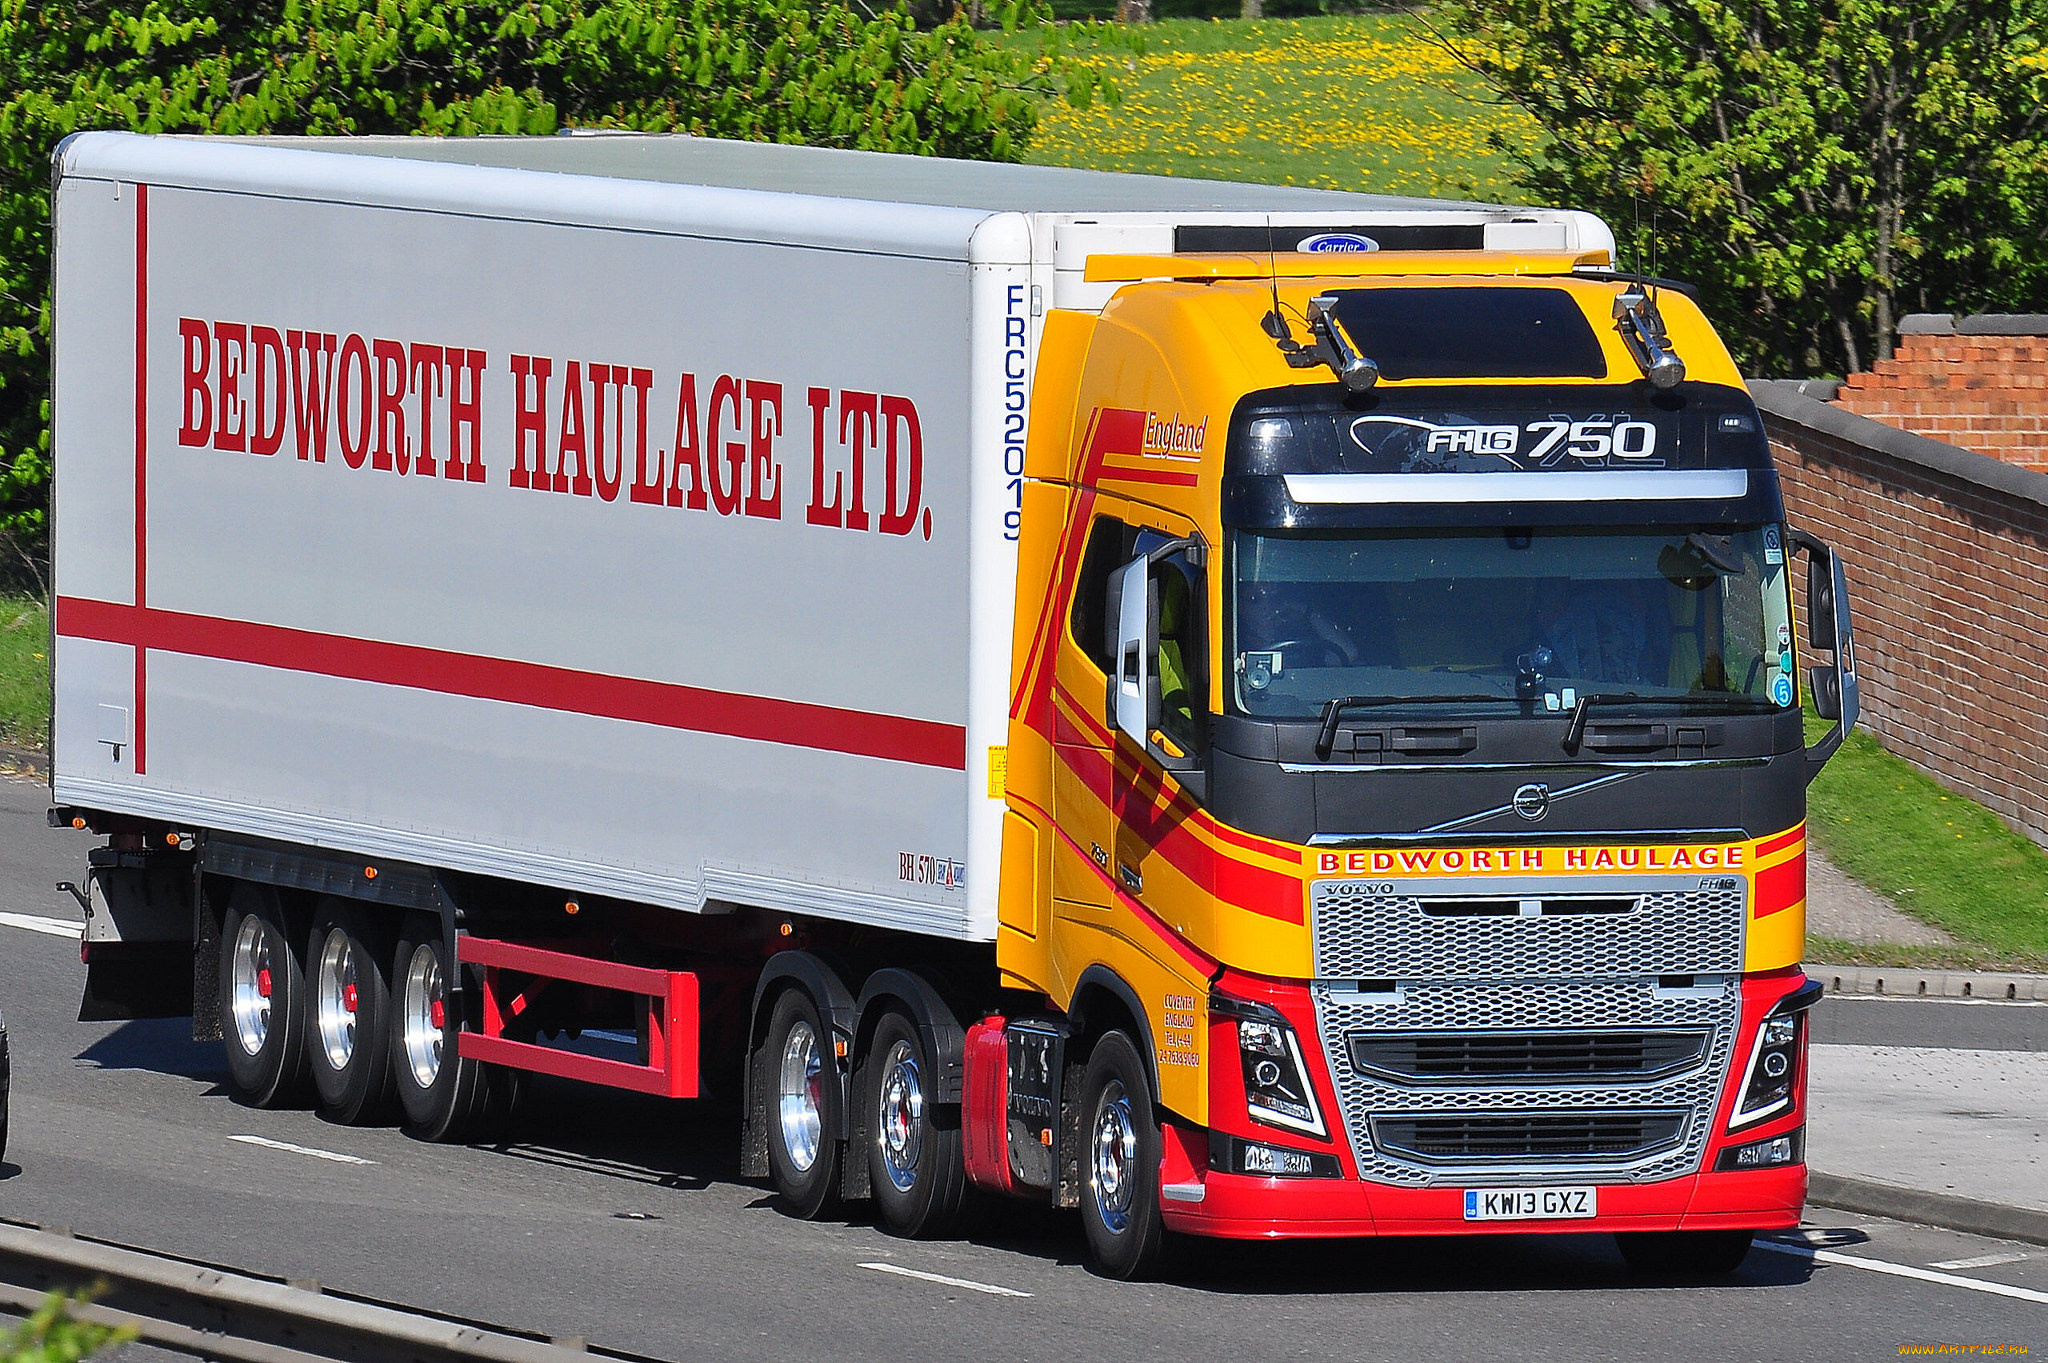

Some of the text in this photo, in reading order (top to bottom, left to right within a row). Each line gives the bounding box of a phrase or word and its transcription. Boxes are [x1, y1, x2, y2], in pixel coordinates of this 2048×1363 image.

[1317, 241, 1360, 253] Carrier
[178, 316, 934, 543] BEDWORTH HAULAGE LTD.
[1145, 411, 1208, 457] England
[1427, 421, 1657, 458] FH16 750
[899, 851, 915, 882] BH
[918, 855, 936, 885] 570
[1317, 846, 1744, 874] BEDWORTH HAULAGE
[1321, 883, 1395, 896] VOLVO
[1164, 993, 1196, 1011] COVENTRY
[1164, 1012, 1195, 1030] ENGLAND
[1485, 1191, 1588, 1215] KW13 GXZ
